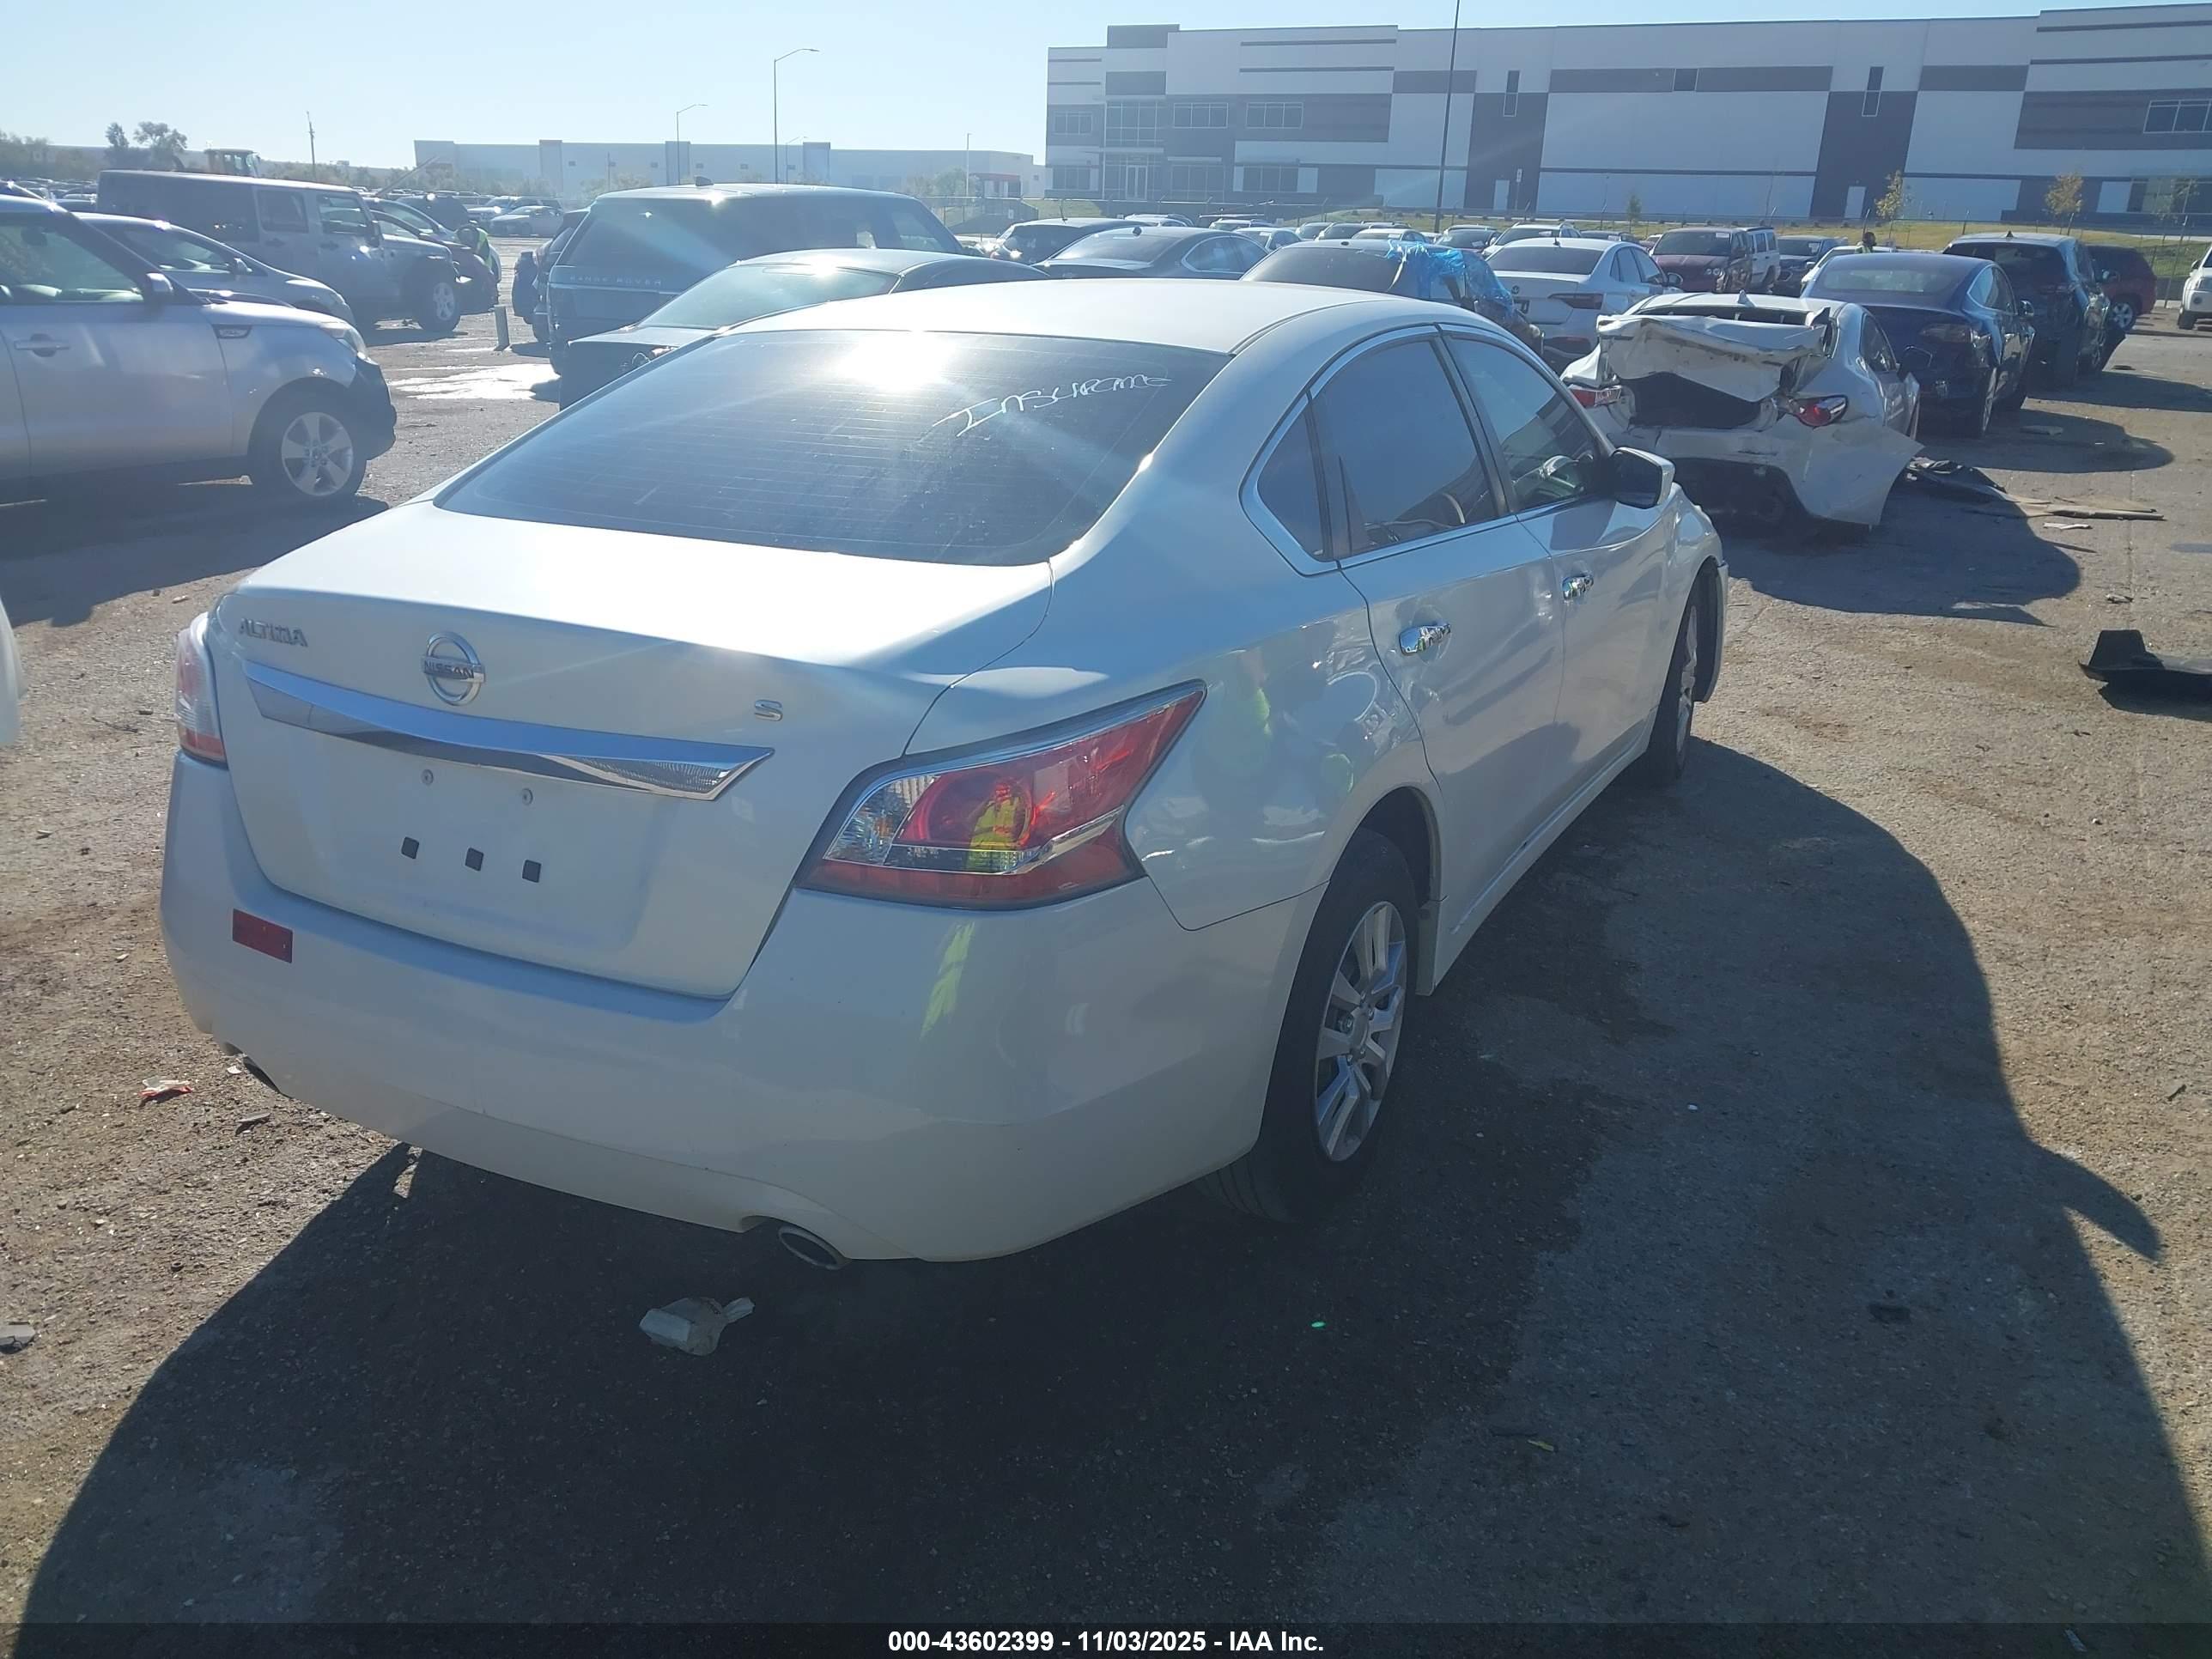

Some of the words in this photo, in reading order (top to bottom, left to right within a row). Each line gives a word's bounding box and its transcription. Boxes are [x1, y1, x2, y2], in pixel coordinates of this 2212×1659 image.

[240, 617, 308, 647] ALTIMA
[424, 659, 475, 680] NISSAN
[754, 699, 783, 722] S
